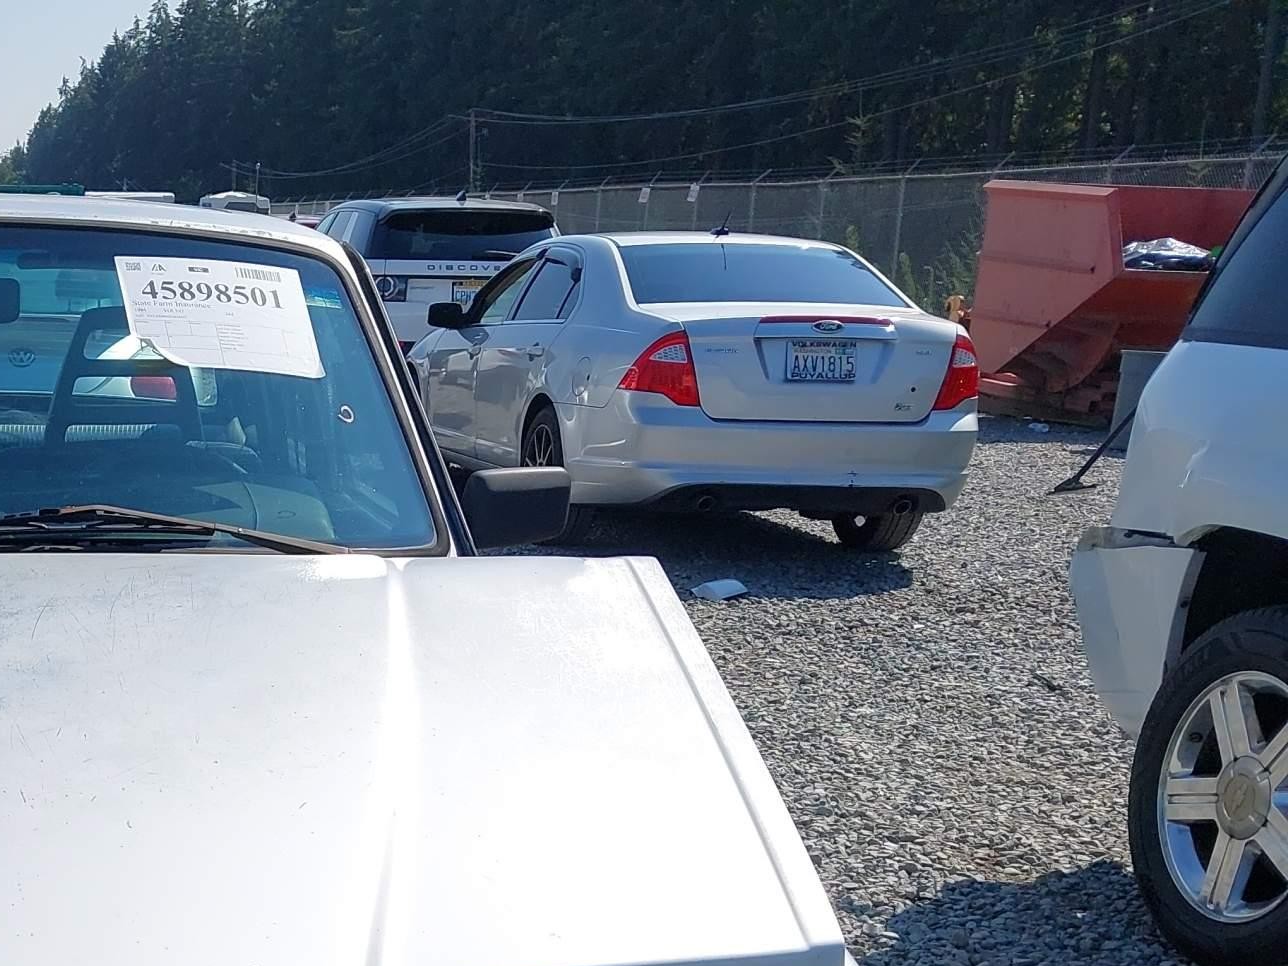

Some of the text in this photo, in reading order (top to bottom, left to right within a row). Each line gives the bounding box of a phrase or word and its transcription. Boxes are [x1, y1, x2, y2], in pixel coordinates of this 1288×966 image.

[141, 279, 285, 310] 45898501
[175, 301, 211, 309] Insurance
[793, 355, 855, 372] AXV1815
[791, 372, 856, 380] PUYALLUP
